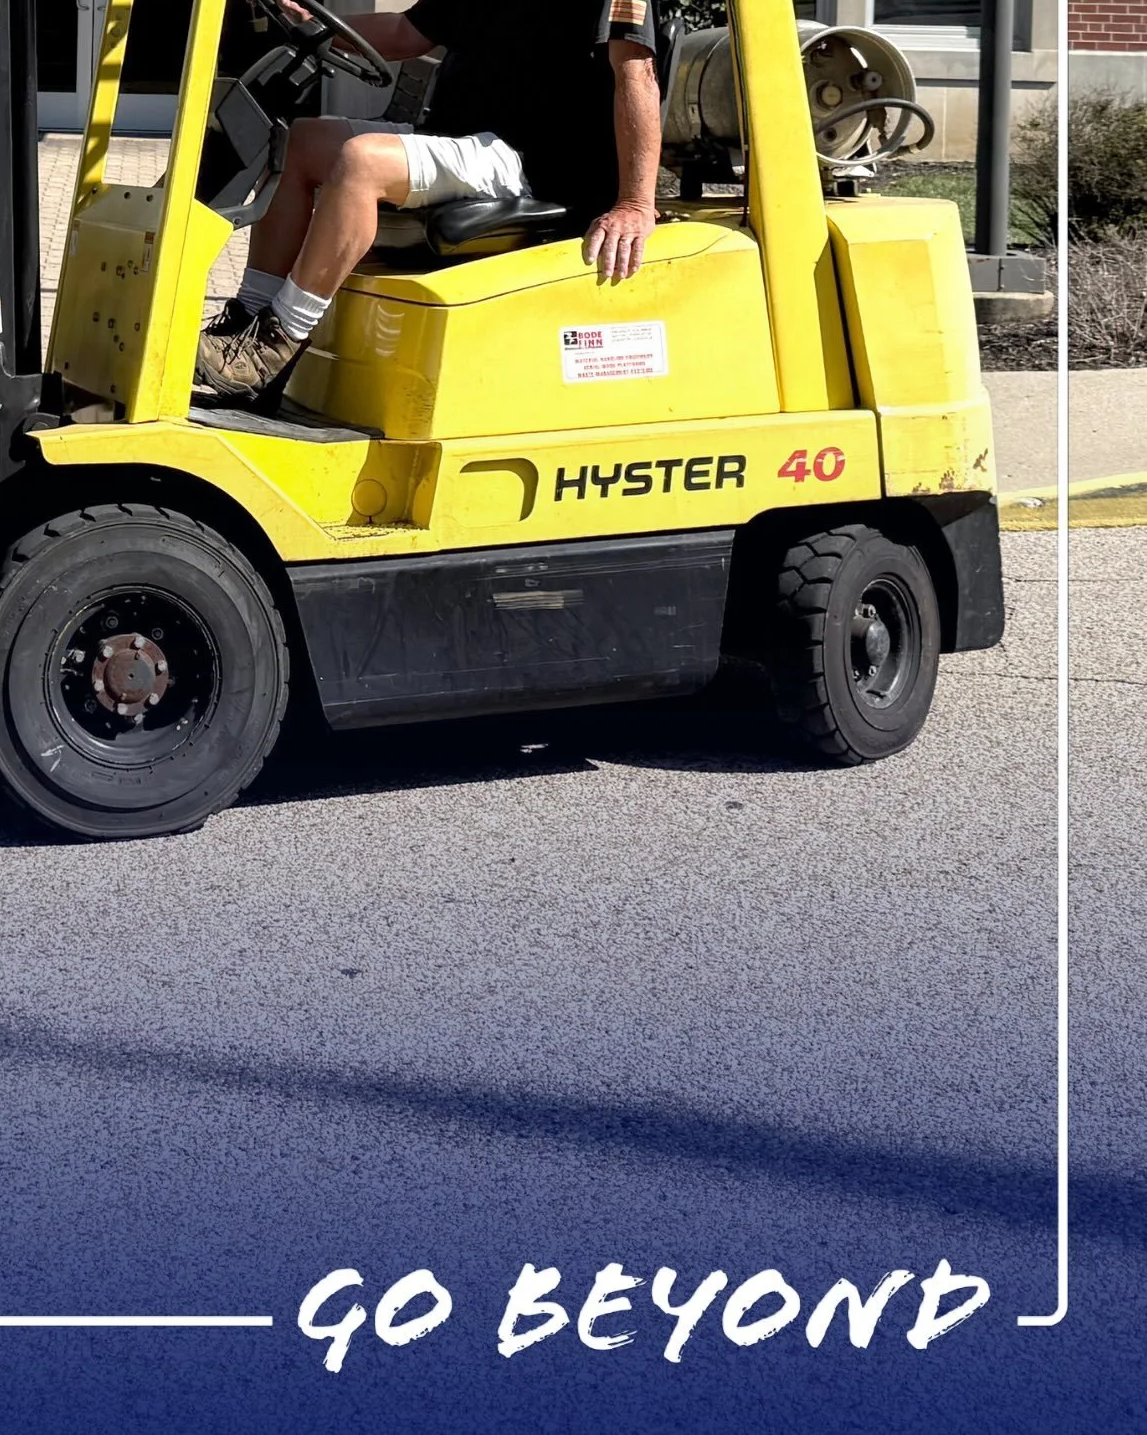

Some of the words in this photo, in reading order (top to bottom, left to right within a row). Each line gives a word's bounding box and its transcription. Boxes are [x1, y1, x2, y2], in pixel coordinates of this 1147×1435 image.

[578, 331, 602, 339] BODE
[578, 339, 603, 348] FINN
[554, 454, 747, 502] HYSTER
[777, 446, 846, 483] 40
